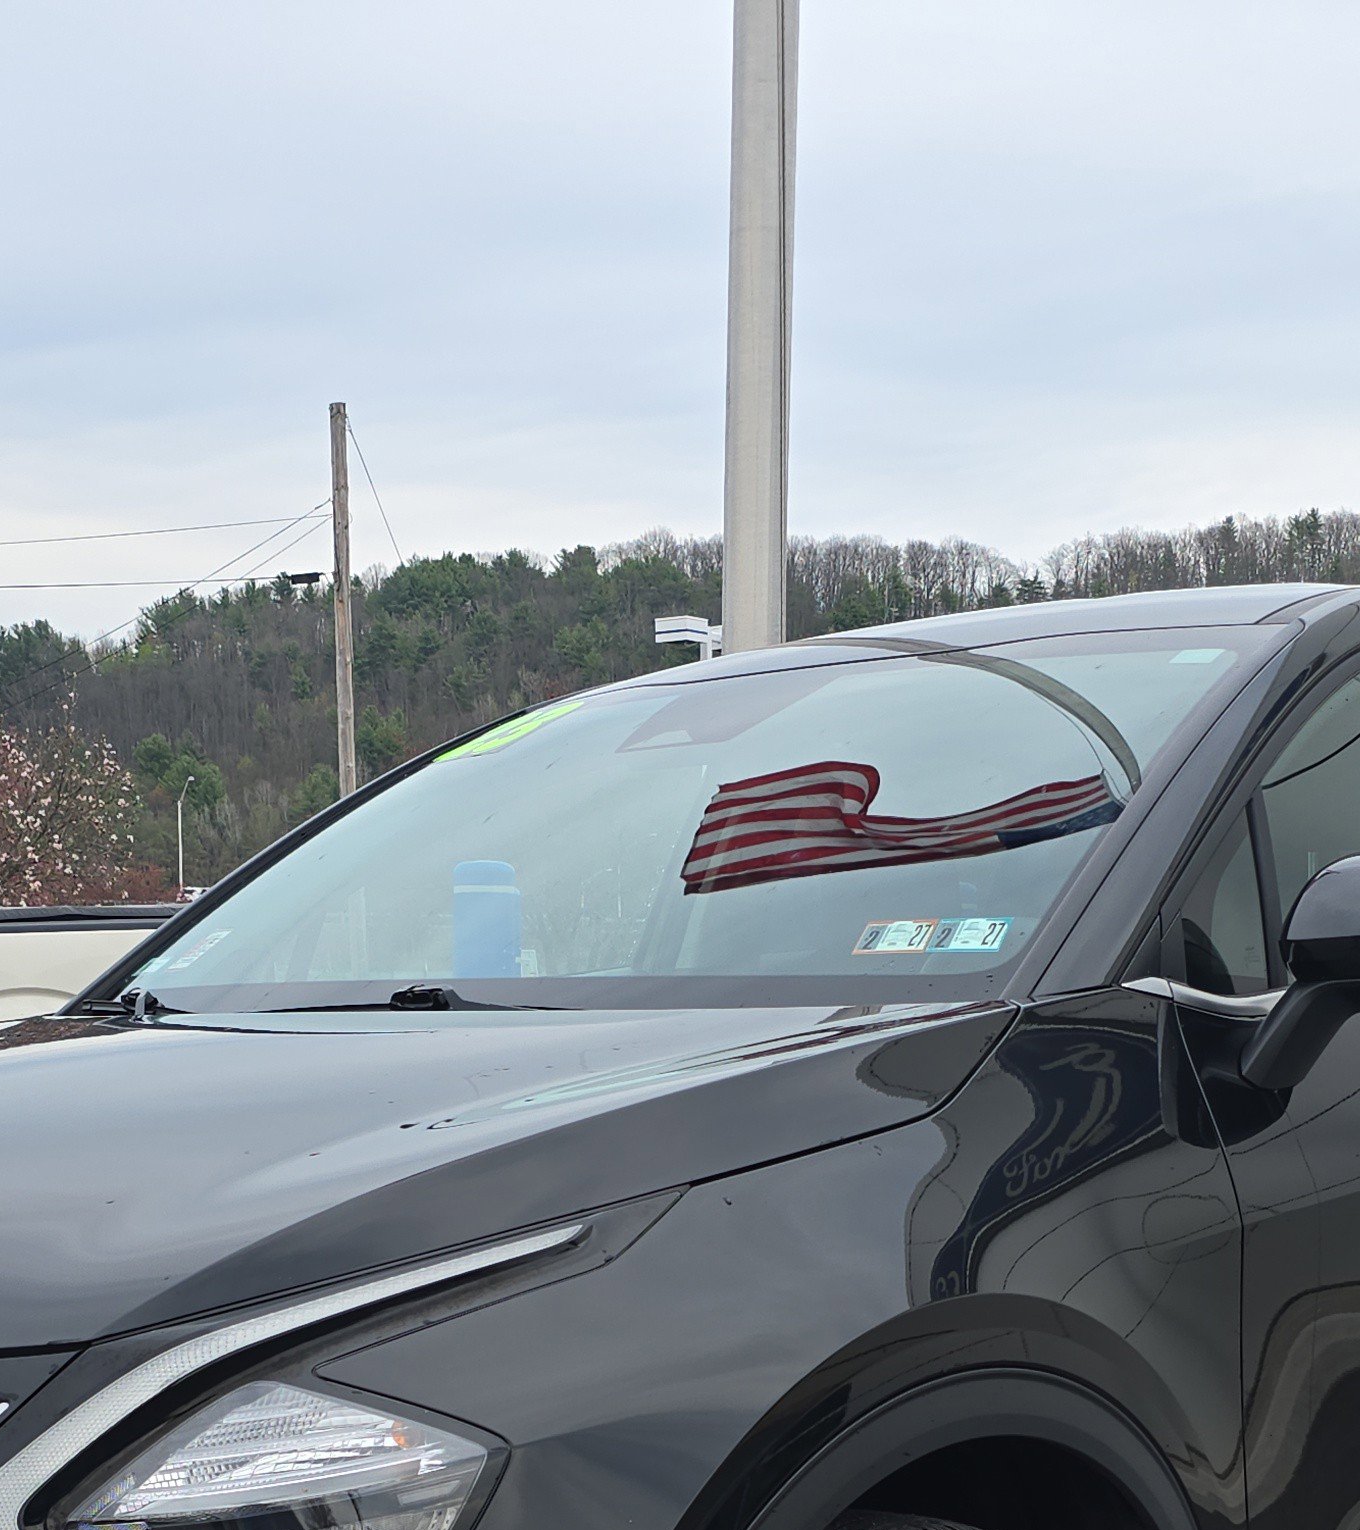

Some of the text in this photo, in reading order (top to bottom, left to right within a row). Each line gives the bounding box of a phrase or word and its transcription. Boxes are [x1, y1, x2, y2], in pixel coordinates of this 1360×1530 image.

[862, 930, 880, 950] 2
[907, 923, 932, 948] 27
[935, 927, 953, 949] 2
[980, 922, 1006, 946] 27
